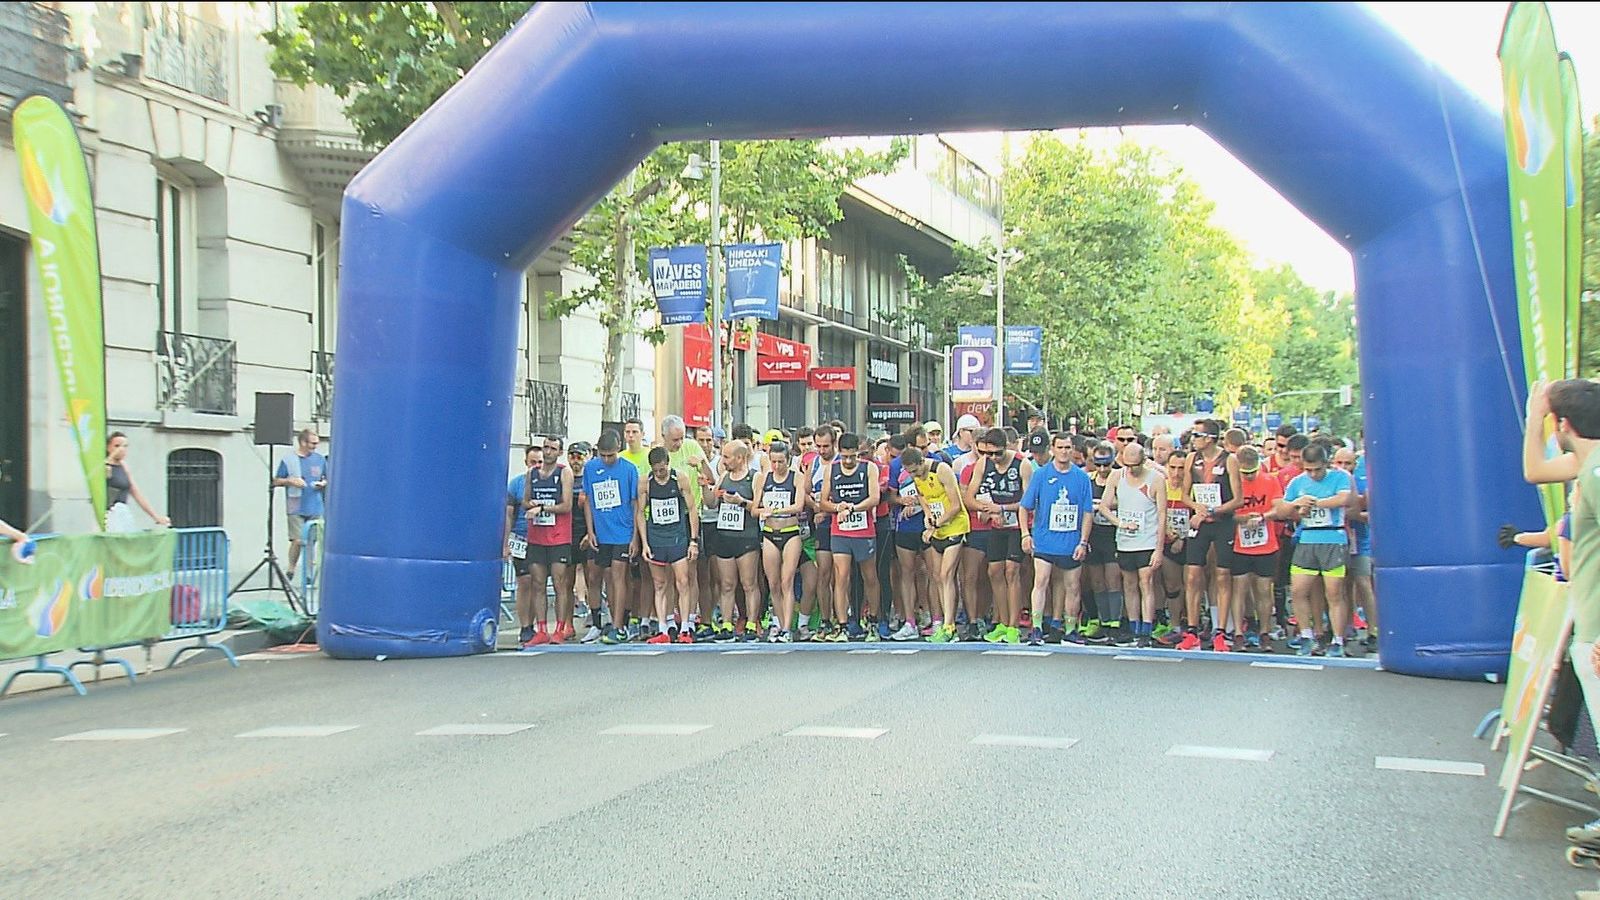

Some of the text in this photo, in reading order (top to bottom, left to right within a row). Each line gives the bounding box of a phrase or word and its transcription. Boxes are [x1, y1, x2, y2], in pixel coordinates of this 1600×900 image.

[655, 263, 702, 280] NAVES
[656, 279, 702, 291] MATADERO
[763, 362, 802, 370] VIPS
[961, 350, 985, 386] P
[815, 373, 851, 381] VIPS
[872, 411, 914, 420] wagamama
[597, 490, 615, 501] 065
[656, 507, 675, 517] 186
[721, 512, 740, 522] 600
